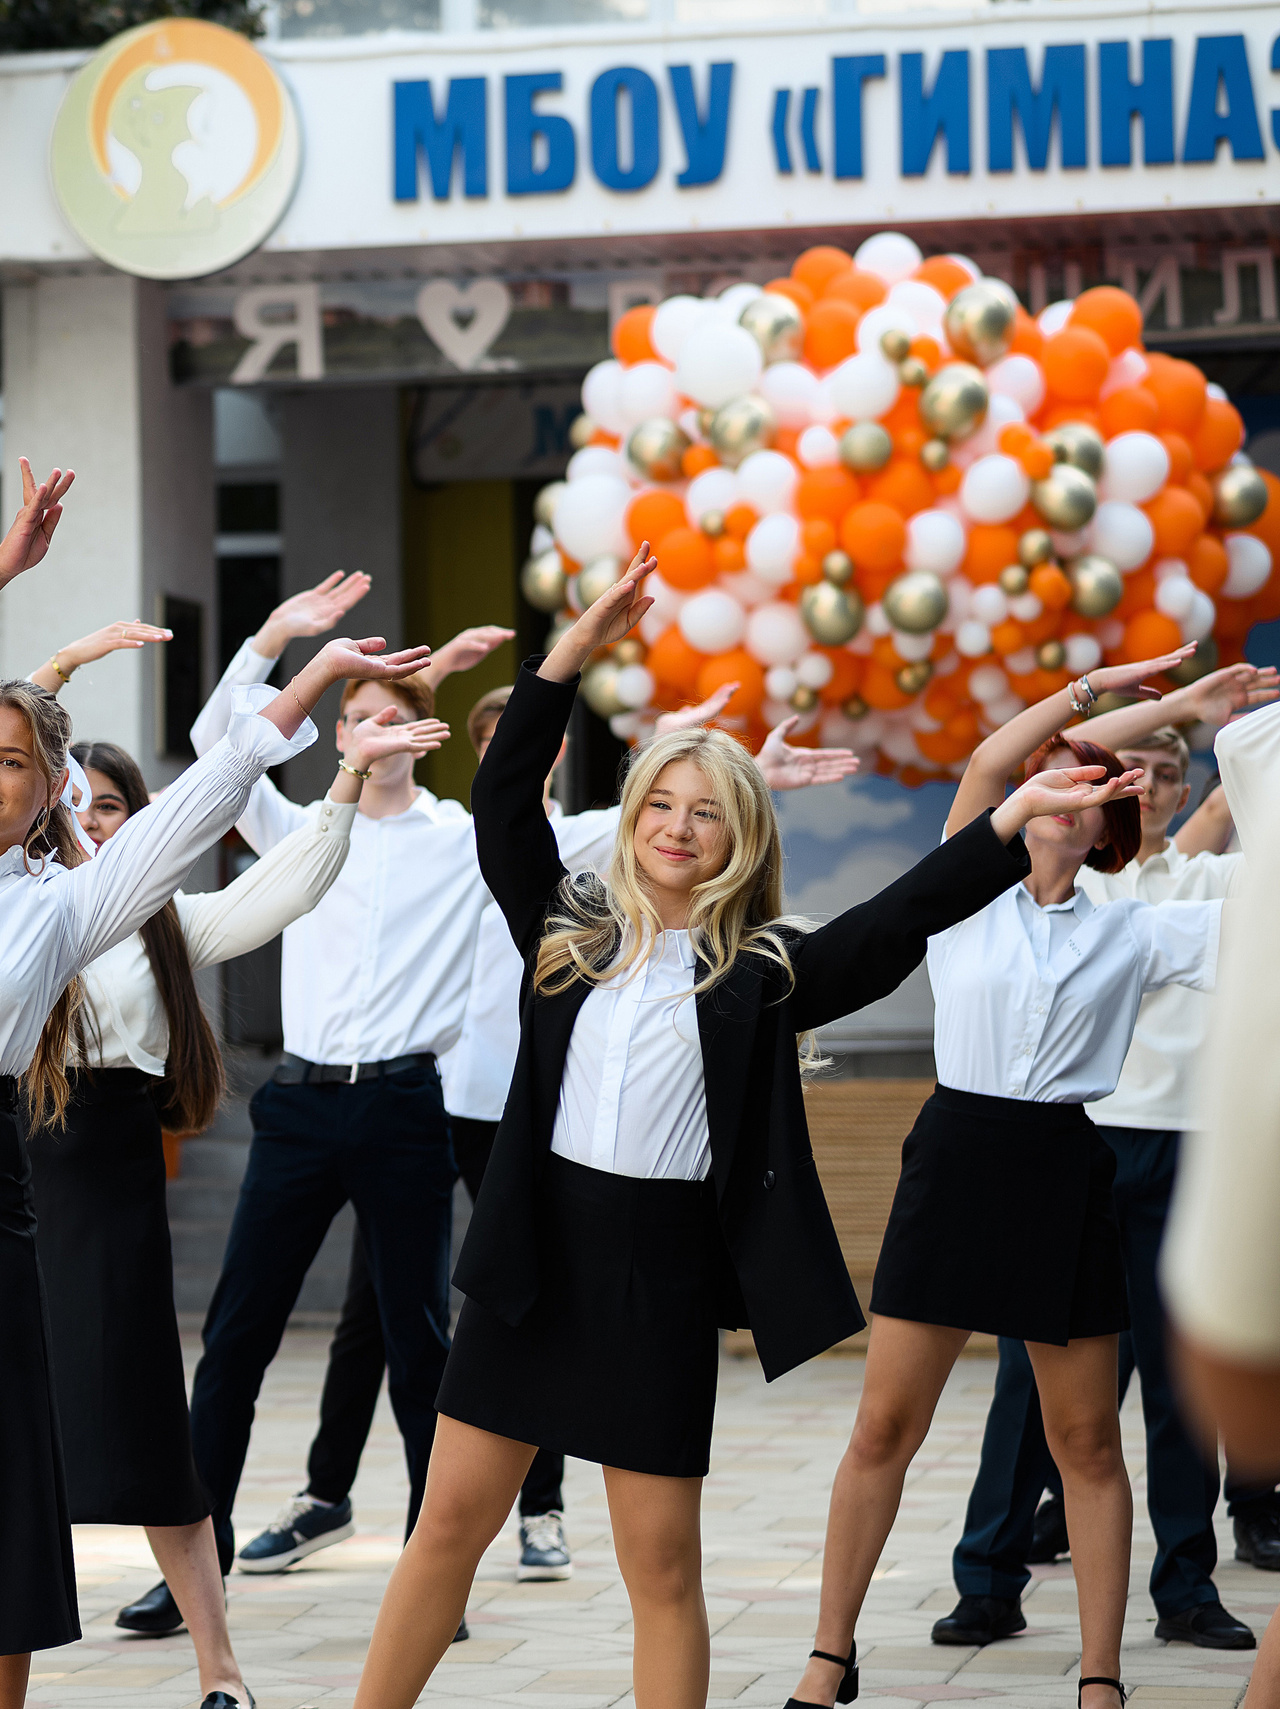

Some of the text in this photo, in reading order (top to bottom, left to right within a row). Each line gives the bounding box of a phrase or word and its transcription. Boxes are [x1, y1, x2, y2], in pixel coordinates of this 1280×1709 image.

[393, 32, 1280, 201] МБОУ «ГИМНА
[231, 283, 324, 385] Я
